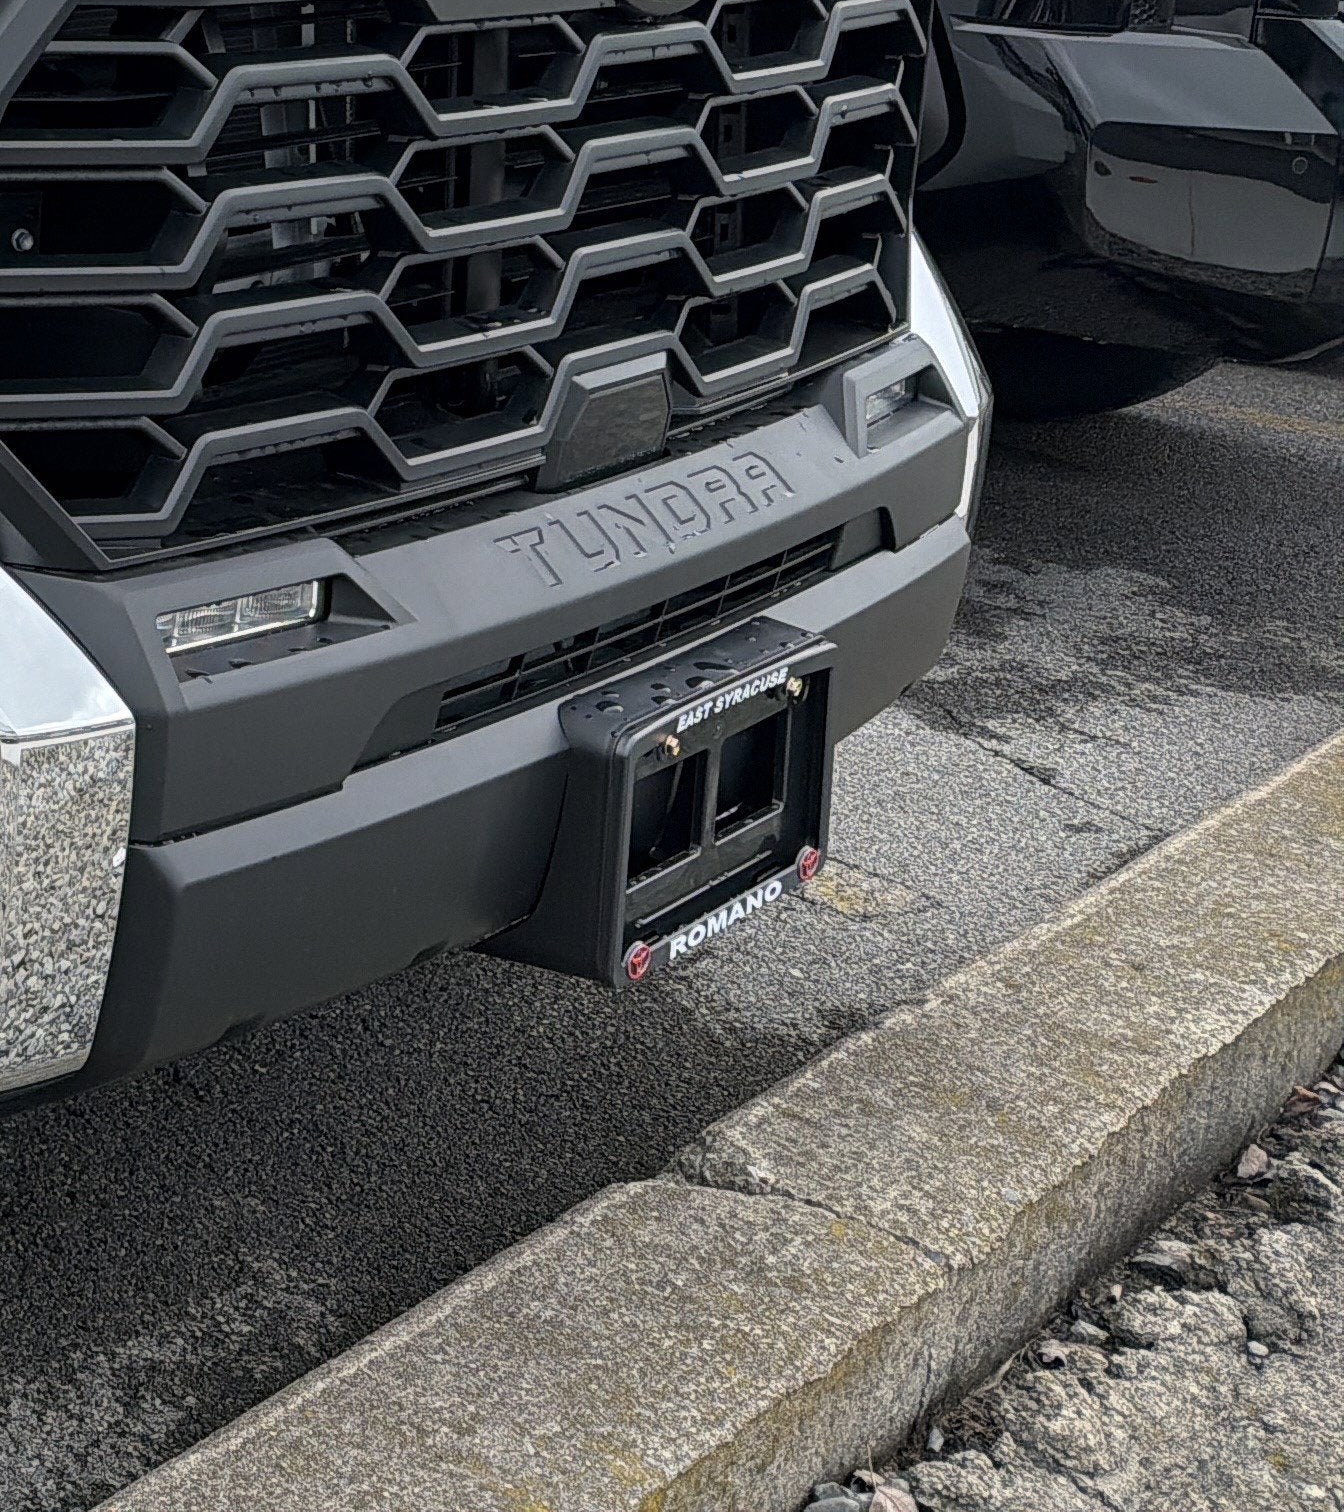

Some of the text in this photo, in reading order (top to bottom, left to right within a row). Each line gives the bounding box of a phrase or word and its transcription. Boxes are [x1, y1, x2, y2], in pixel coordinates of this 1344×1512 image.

[493, 451, 795, 587] TUNDRA
[677, 666, 789, 734] EAST SYRACUSE
[669, 881, 783, 960] ROMANO
